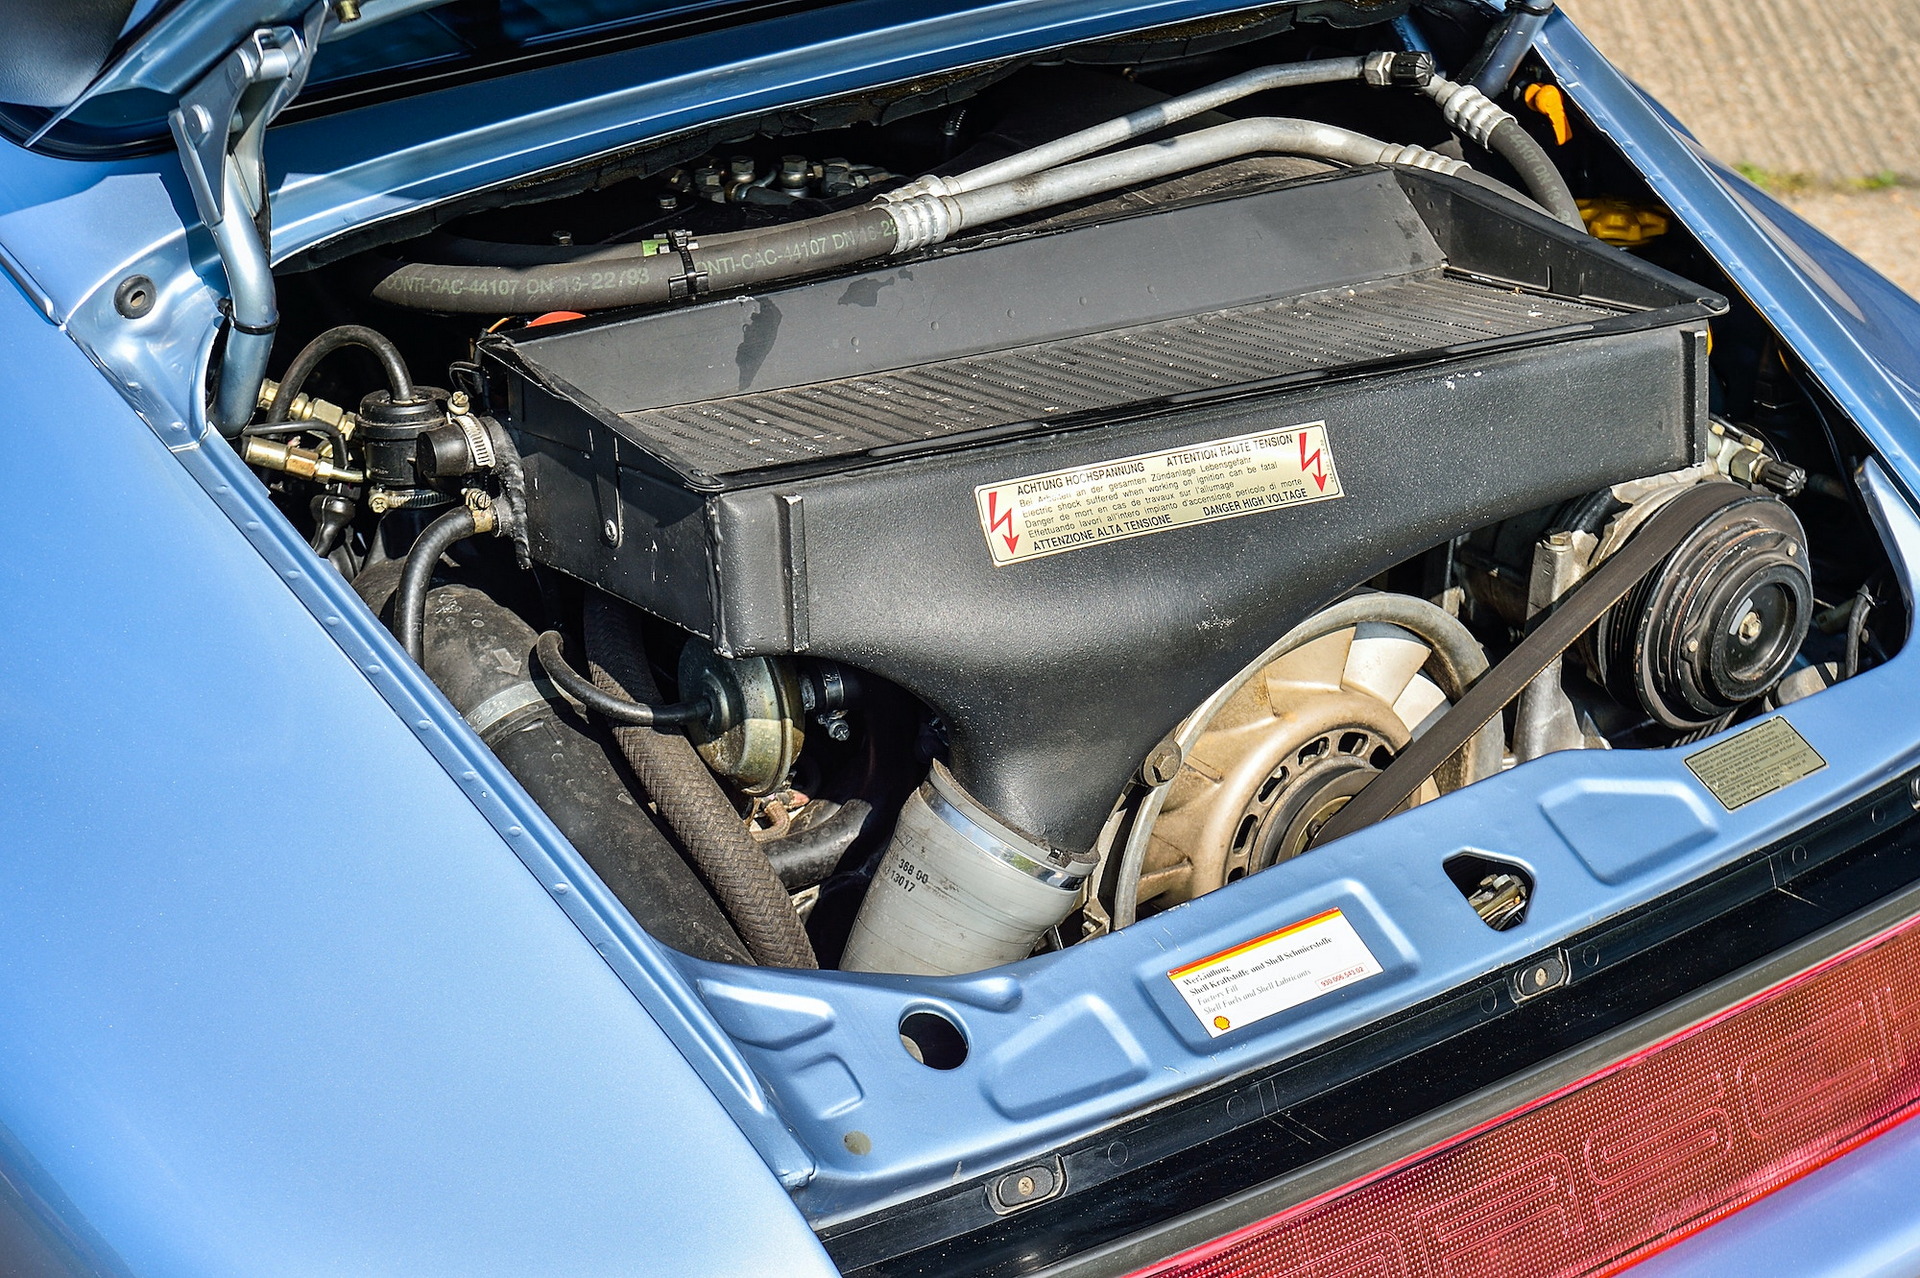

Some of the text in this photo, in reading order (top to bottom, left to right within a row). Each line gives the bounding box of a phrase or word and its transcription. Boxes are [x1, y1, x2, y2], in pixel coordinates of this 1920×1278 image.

[831, 233, 855, 251] DN
[526, 278, 553, 295] DN
[1166, 433, 1293, 467] ATTENTION HAUTE TENSION
[1017, 461, 1145, 496] ACHTUNG HOCHSPANNUNG
[1018, 456, 1251, 508] Bei Arbten an der gesamten Zündanlage Lebensgefahr
[1022, 461, 1278, 519] Electric shock suffered when working on ignition can be fatal
[1024, 481, 1235, 529] Danger de mort en cas de travaux sur l'allumage
[1027, 478, 1303, 538] Effettuando lavori all'intero impianto d'accensione pericolo di morte
[1202, 487, 1308, 517] DANGER HIGH VOLTAGE
[1033, 513, 1173, 551] ATTENZIONE ALTA TENSIONE
[891, 870, 916, 892] 13017
[898, 858, 915, 875] 368
[915, 869, 929, 884] 00
[1189, 937, 1332, 995] Shell Kraftstoffe und Shell Schmierstoffe
[1203, 1002, 1222, 1015] Shell
[1221, 995, 1242, 1008] Fuels
[1242, 988, 1257, 1000] and
[1255, 981, 1275, 994] Shell
[1224, 984, 1239, 995] Fill
